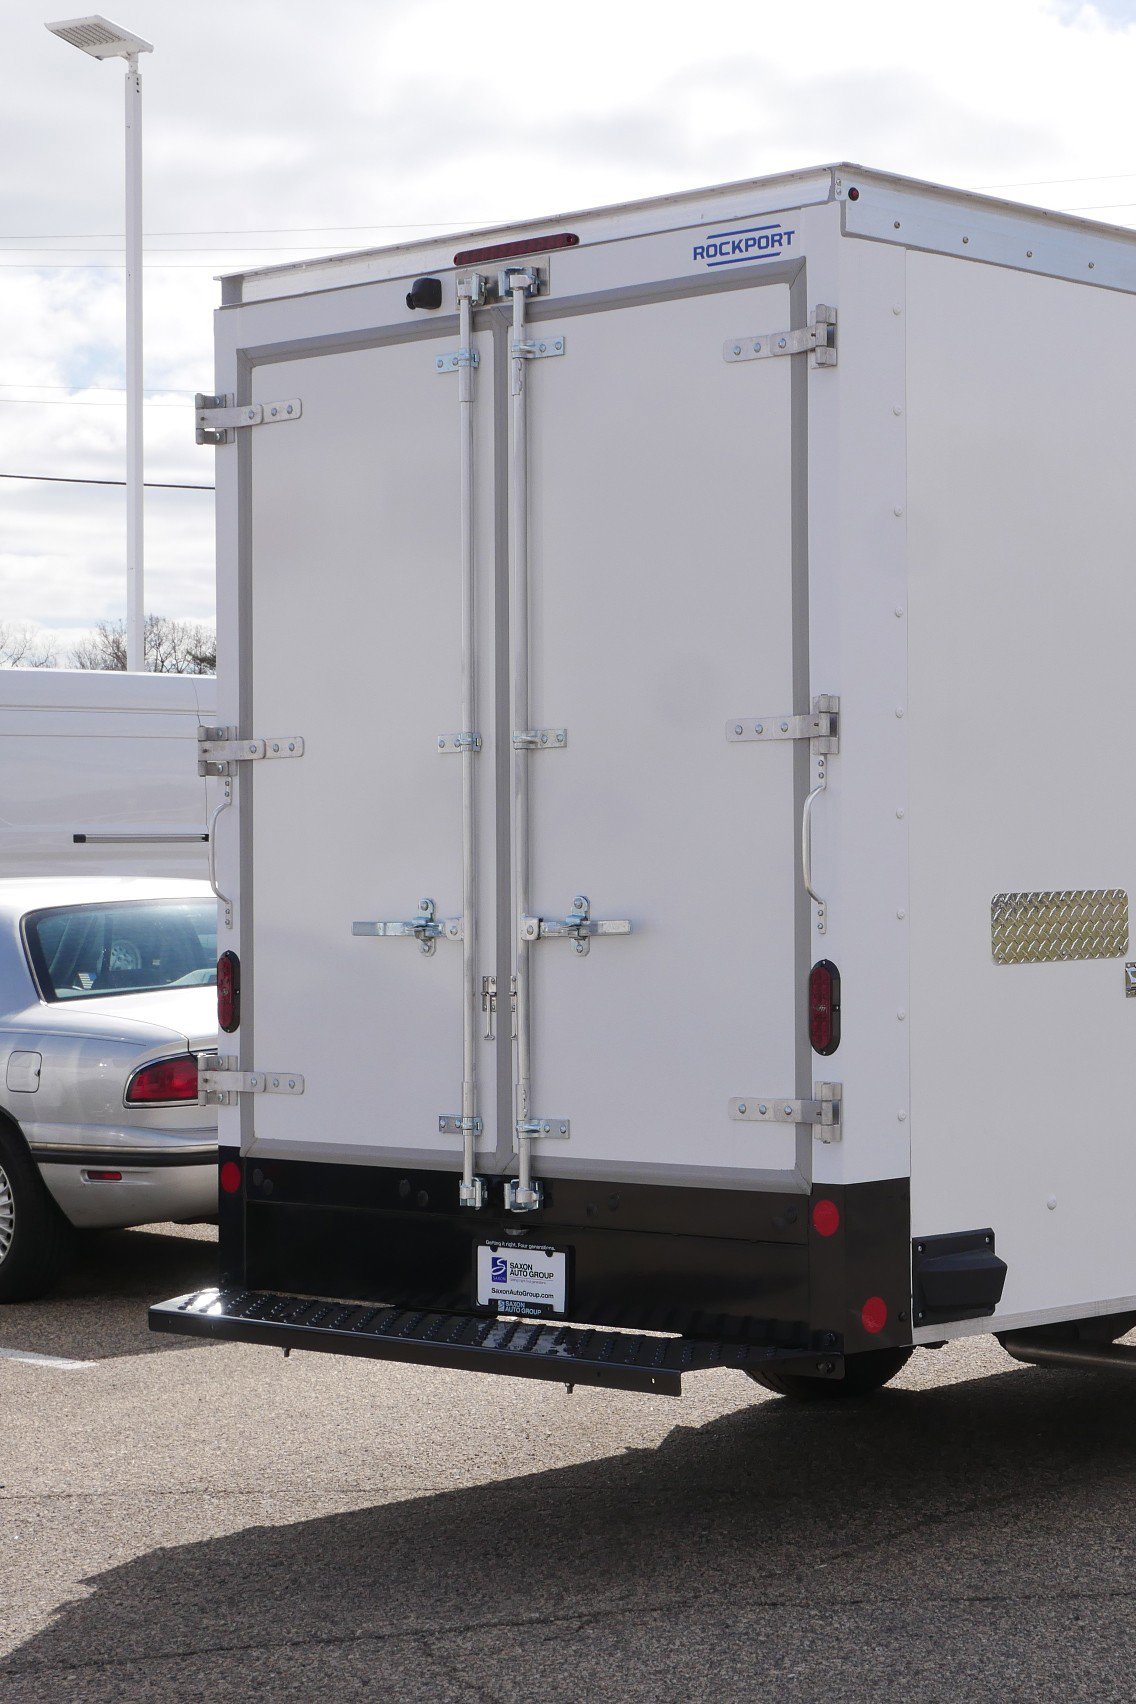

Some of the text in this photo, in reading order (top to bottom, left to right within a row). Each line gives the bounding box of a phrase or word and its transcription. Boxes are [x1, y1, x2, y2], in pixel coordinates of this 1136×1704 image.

[693, 230, 796, 260] ROCKPORT
[509, 1262, 532, 1270] SAXON
[509, 1269, 554, 1279] AUTO GROUP
[491, 1287, 554, 1298] SaxonAutoGroup.com
[505, 1300, 526, 1308] SAXON
[521, 1307, 542, 1315] GROUP
